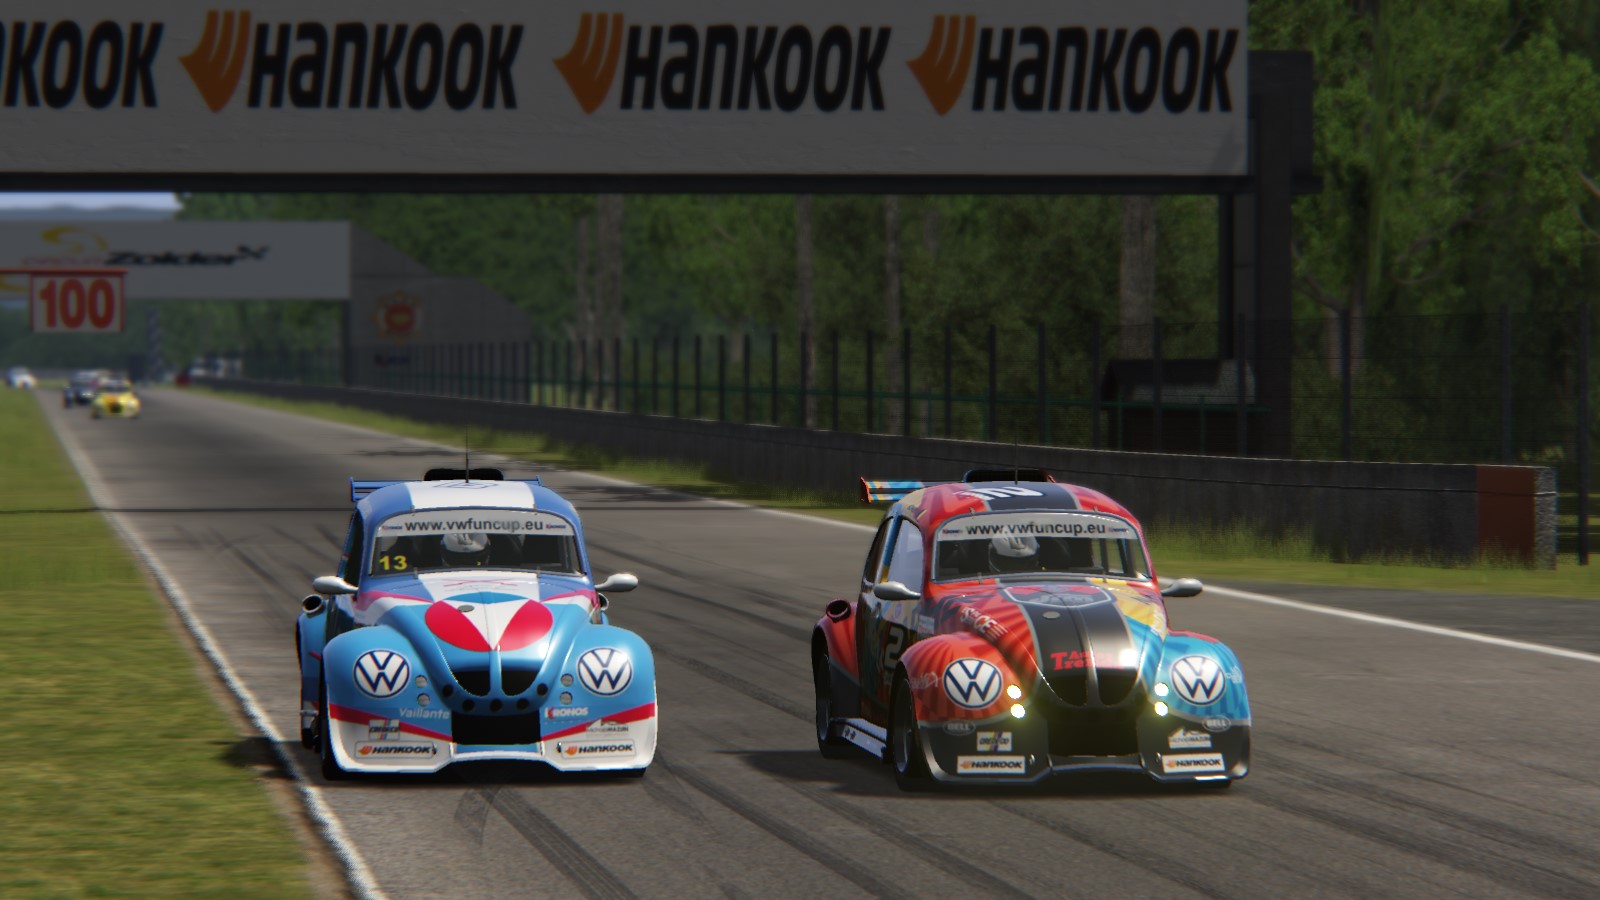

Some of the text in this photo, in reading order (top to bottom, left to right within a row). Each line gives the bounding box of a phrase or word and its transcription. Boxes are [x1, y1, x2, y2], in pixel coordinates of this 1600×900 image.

[0, 20, 164, 109] KOOK
[39, 278, 115, 330] 100
[405, 518, 543, 533] www.vwfuncup.eu
[966, 521, 1106, 536] www.vwfuncup.eu
[379, 555, 407, 571] 13
[400, 707, 450, 719] Vaillante
